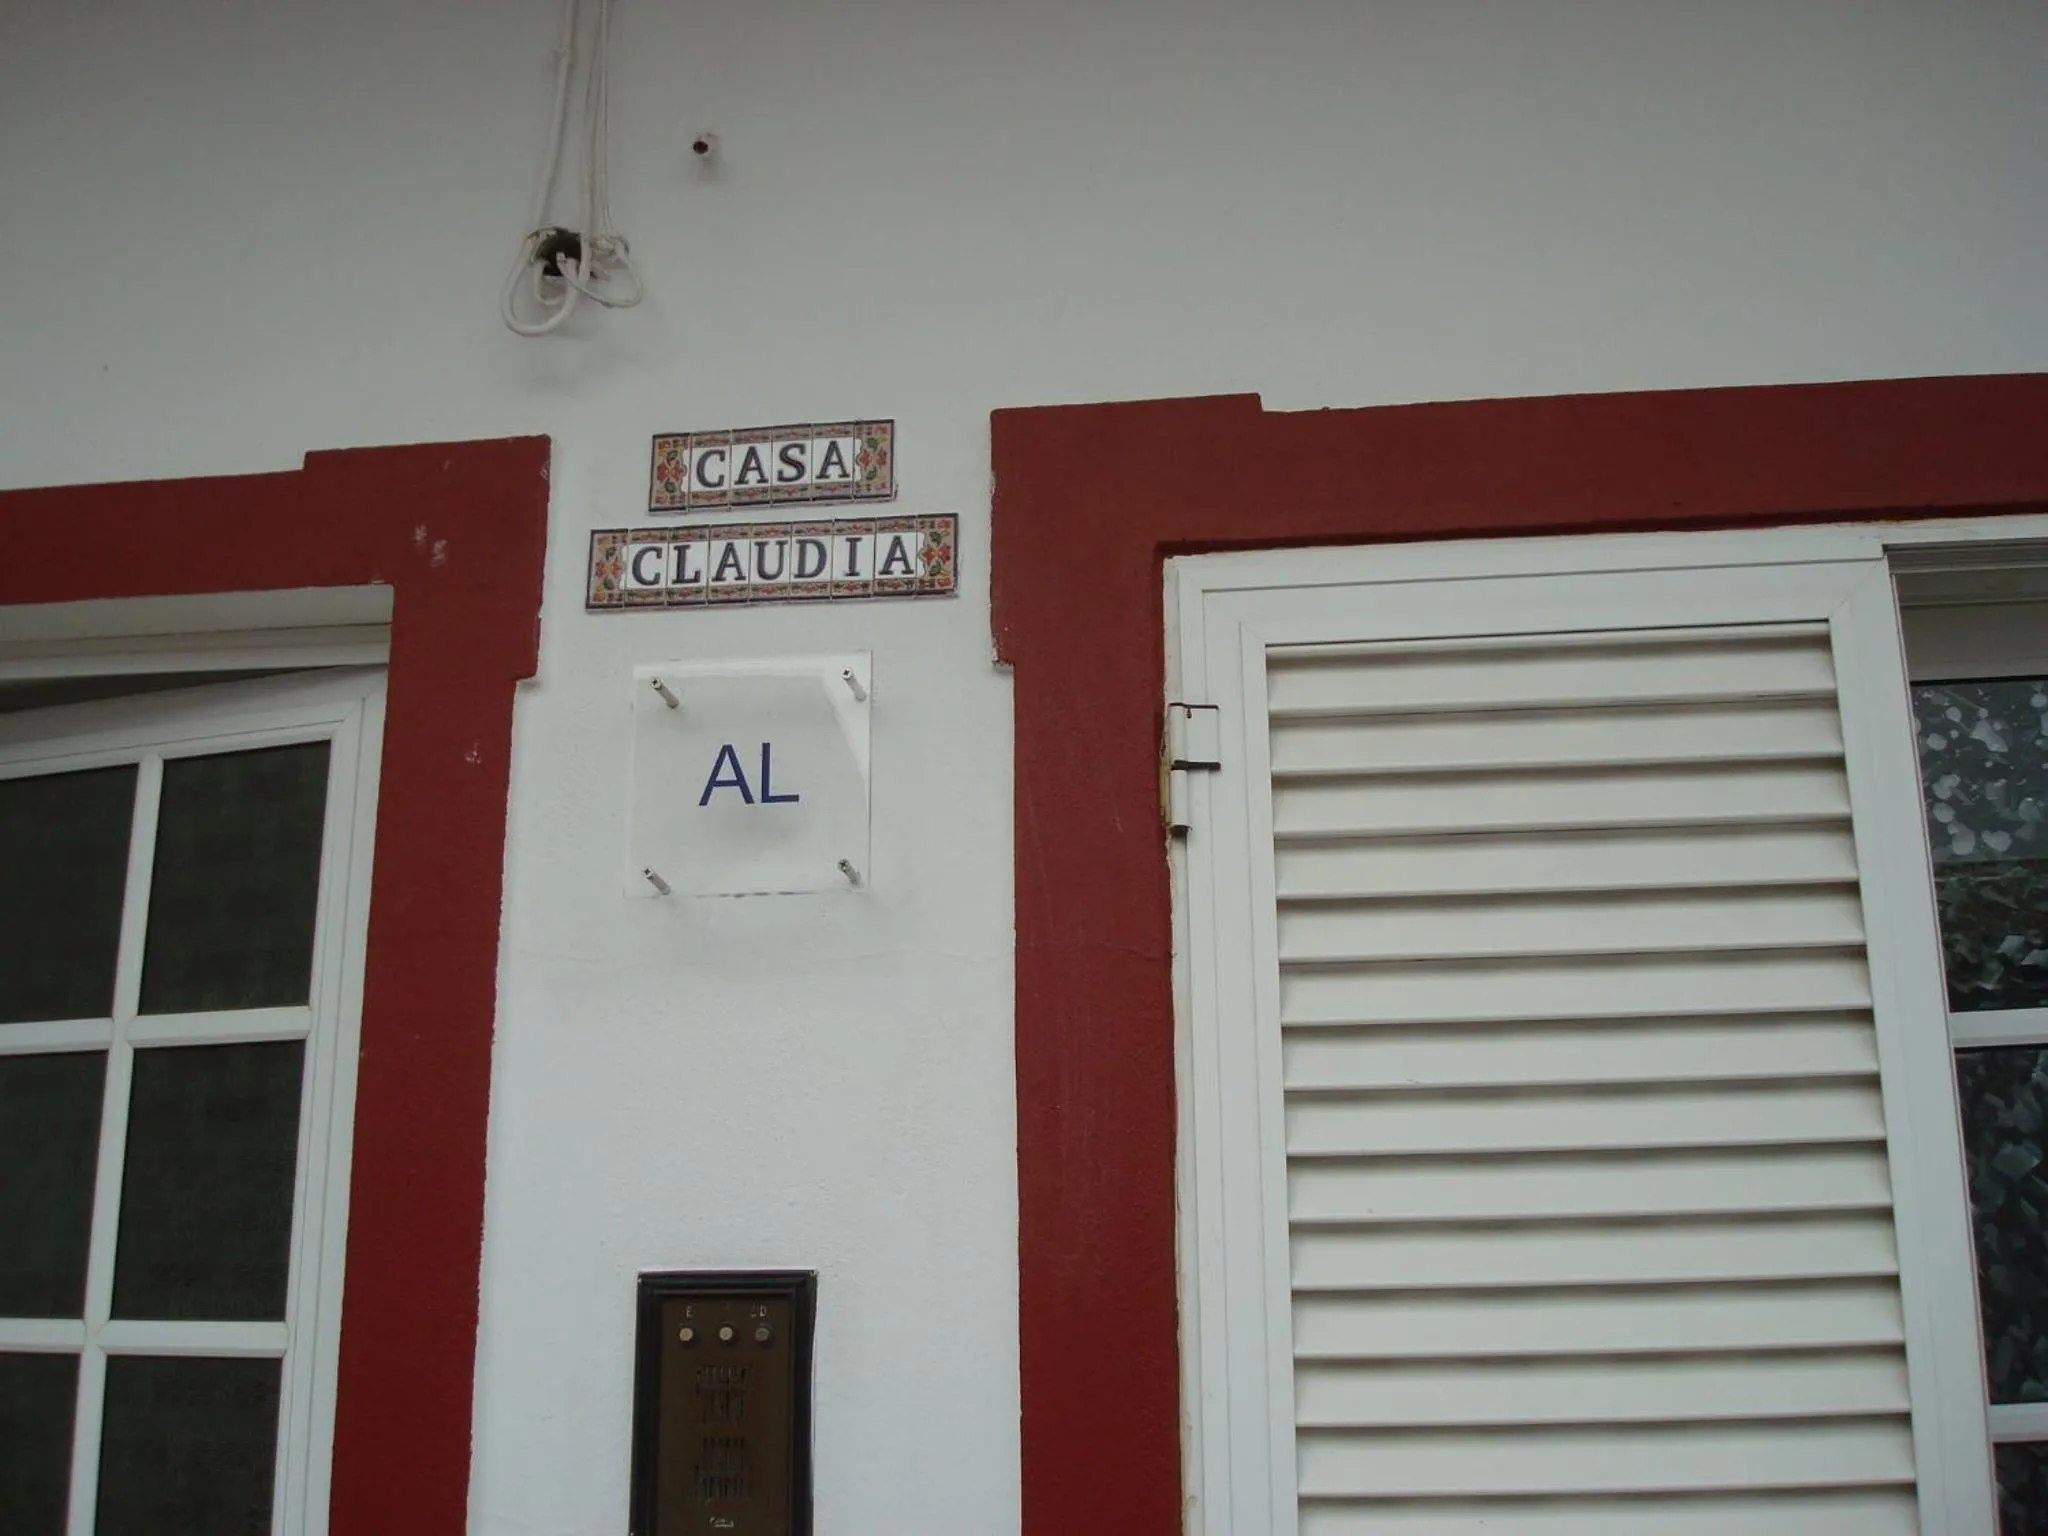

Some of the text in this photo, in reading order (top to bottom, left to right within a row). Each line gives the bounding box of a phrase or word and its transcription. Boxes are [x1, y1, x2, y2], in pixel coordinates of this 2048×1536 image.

[695, 440, 850, 488] CASA
[631, 535, 915, 586] CLAUDIA
[698, 742, 799, 806] AL
